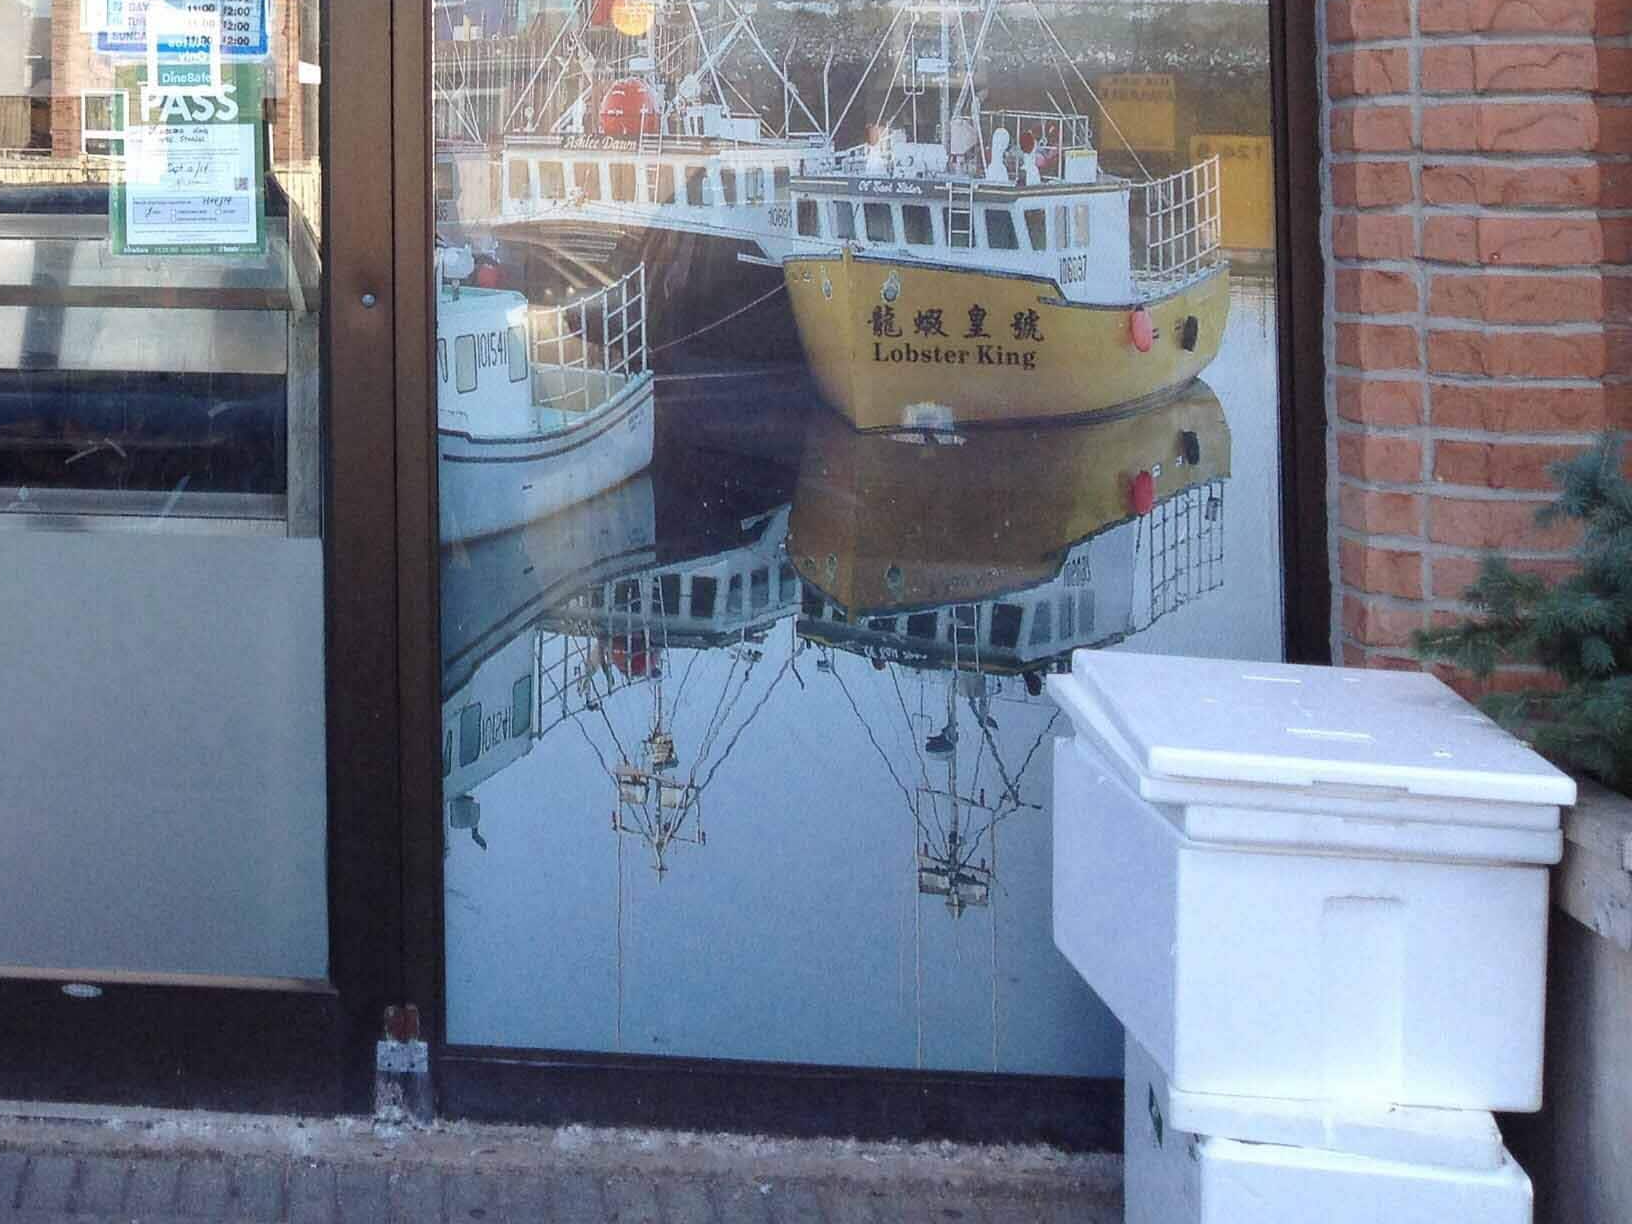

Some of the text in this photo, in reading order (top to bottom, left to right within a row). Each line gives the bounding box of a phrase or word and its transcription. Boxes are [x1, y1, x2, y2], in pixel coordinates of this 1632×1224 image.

[111, 32, 148, 42] SUNDA
[139, 82, 240, 122] PASS
[867, 303, 1045, 343] 龍蝦皇號
[872, 342, 1038, 371] Lobster King
